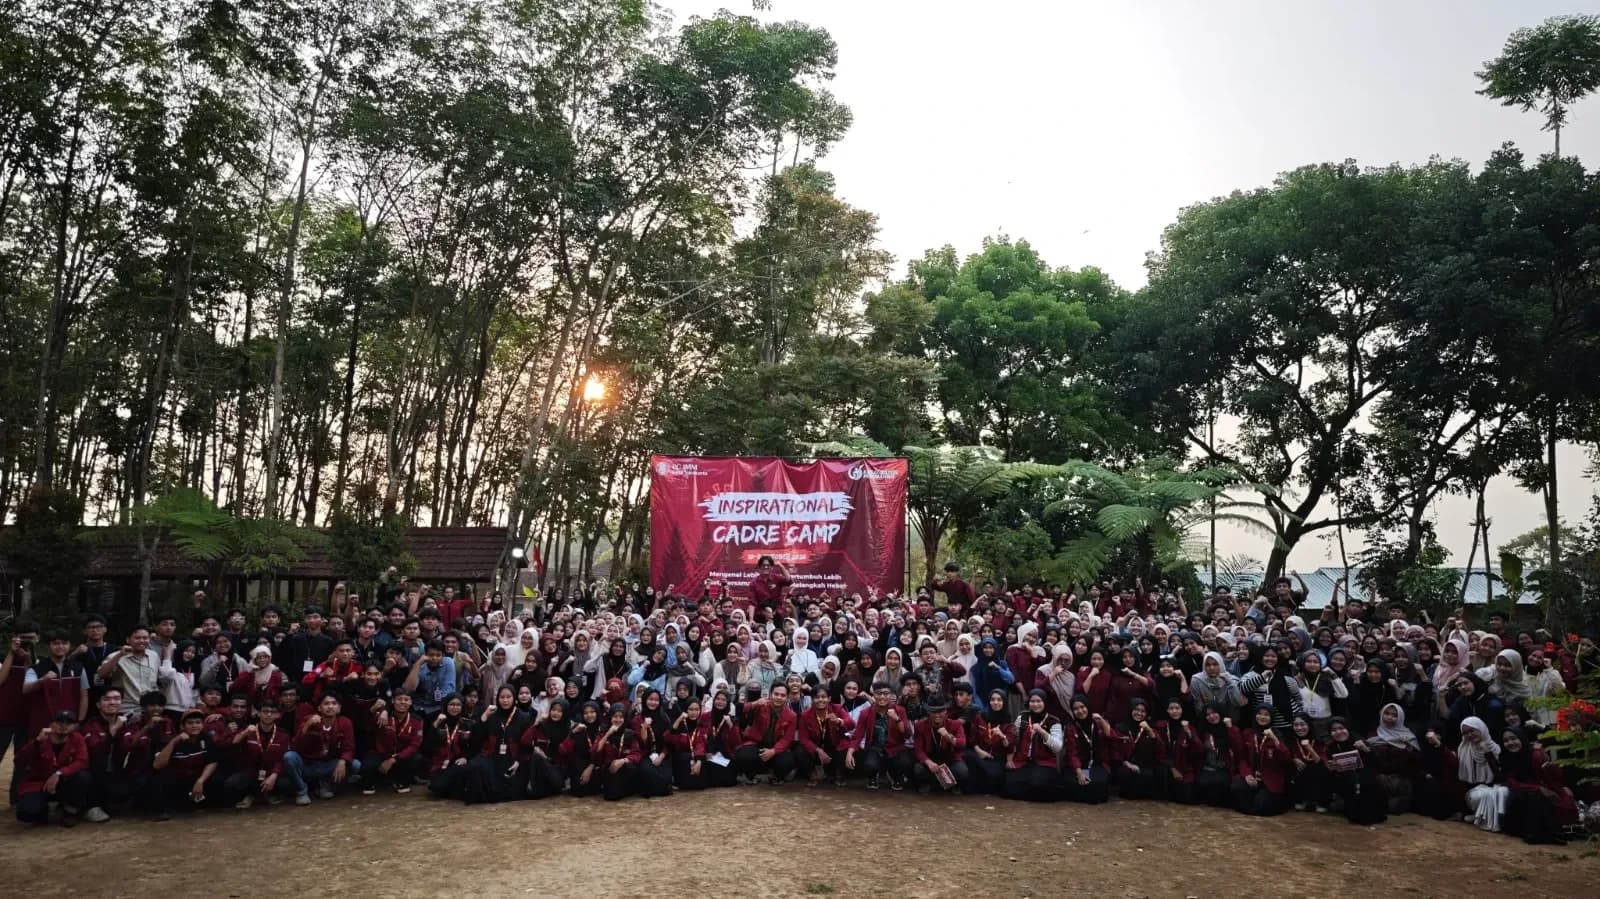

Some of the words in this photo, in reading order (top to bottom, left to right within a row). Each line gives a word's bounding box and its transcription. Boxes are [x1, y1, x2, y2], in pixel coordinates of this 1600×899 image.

[718, 498, 840, 515] INSPIRATIONAL
[713, 524, 780, 546] CADRE
[786, 524, 841, 546] CAMP
